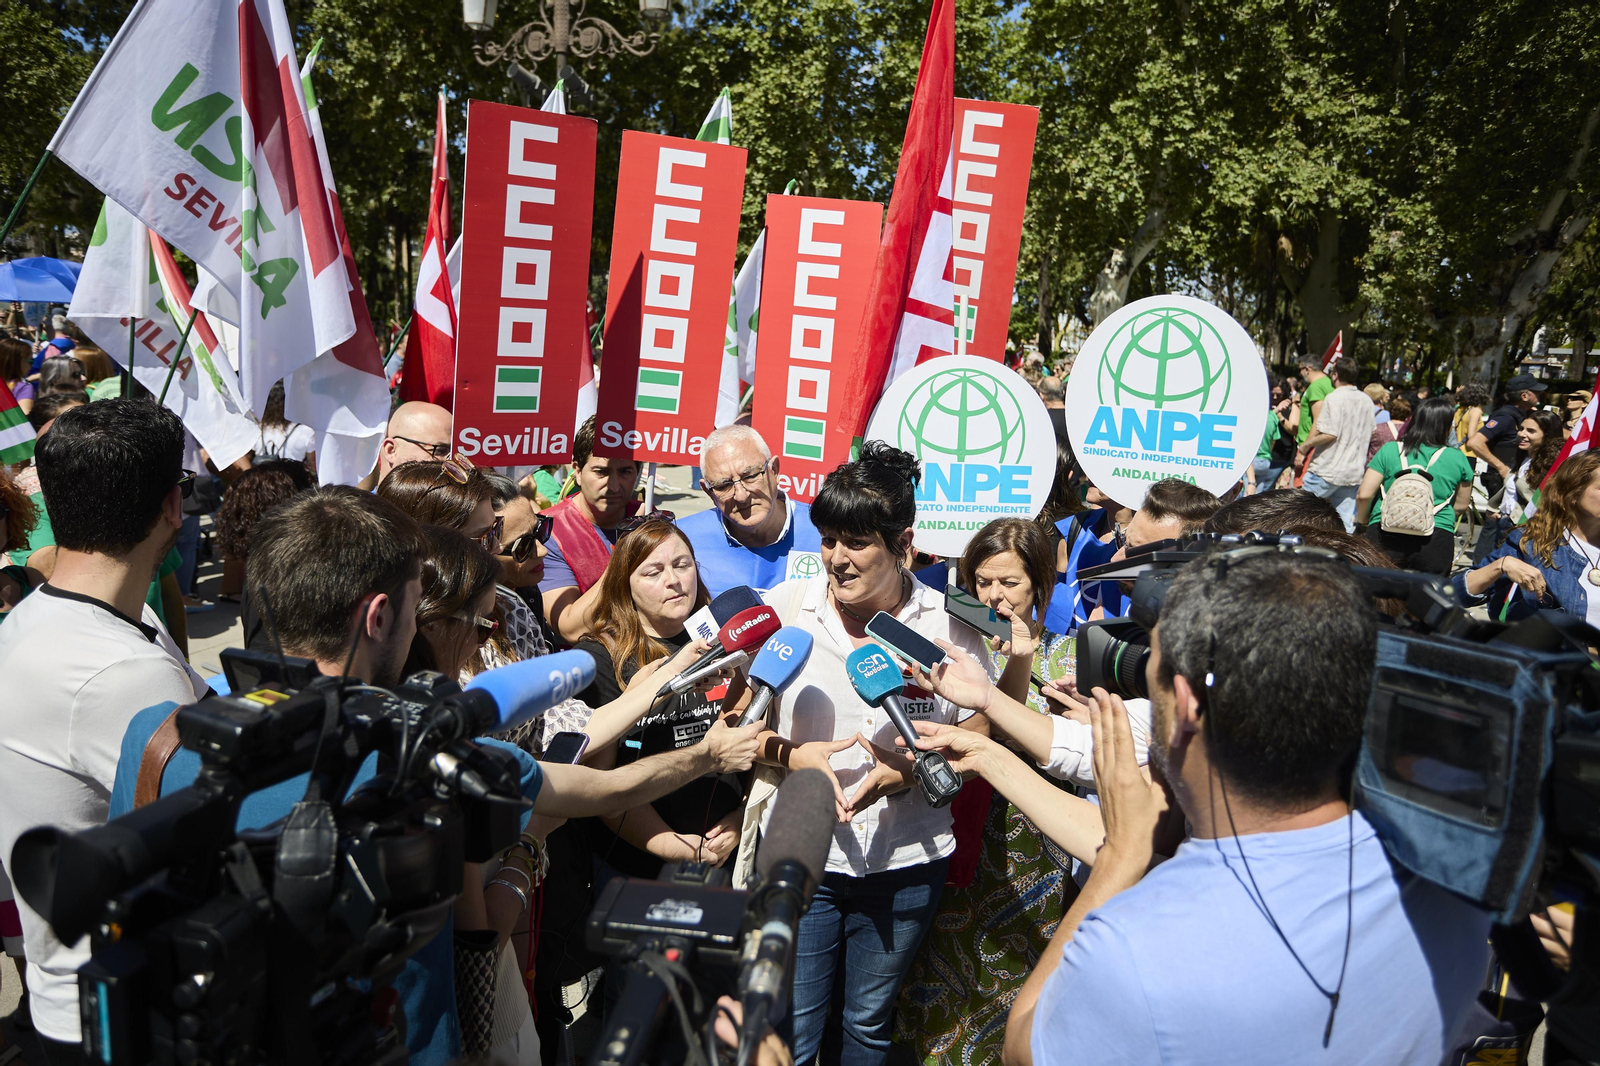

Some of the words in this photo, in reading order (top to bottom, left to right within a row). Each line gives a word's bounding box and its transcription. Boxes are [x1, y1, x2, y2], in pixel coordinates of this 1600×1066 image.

[497, 120, 558, 357] CCOO
[639, 147, 706, 363] CCOO
[786, 208, 845, 413] CCOO
[458, 427, 568, 456] Sevilla
[600, 421, 706, 456] Sevilla
[1084, 406, 1238, 459] ANPE
[1083, 447, 1139, 460] SINDICATO
[1141, 453, 1234, 470] INDEPENDIENTE
[946, 504, 1031, 514] INDEPENDIENTE
[735, 612, 771, 635] esRadio
[766, 637, 794, 661] tve
